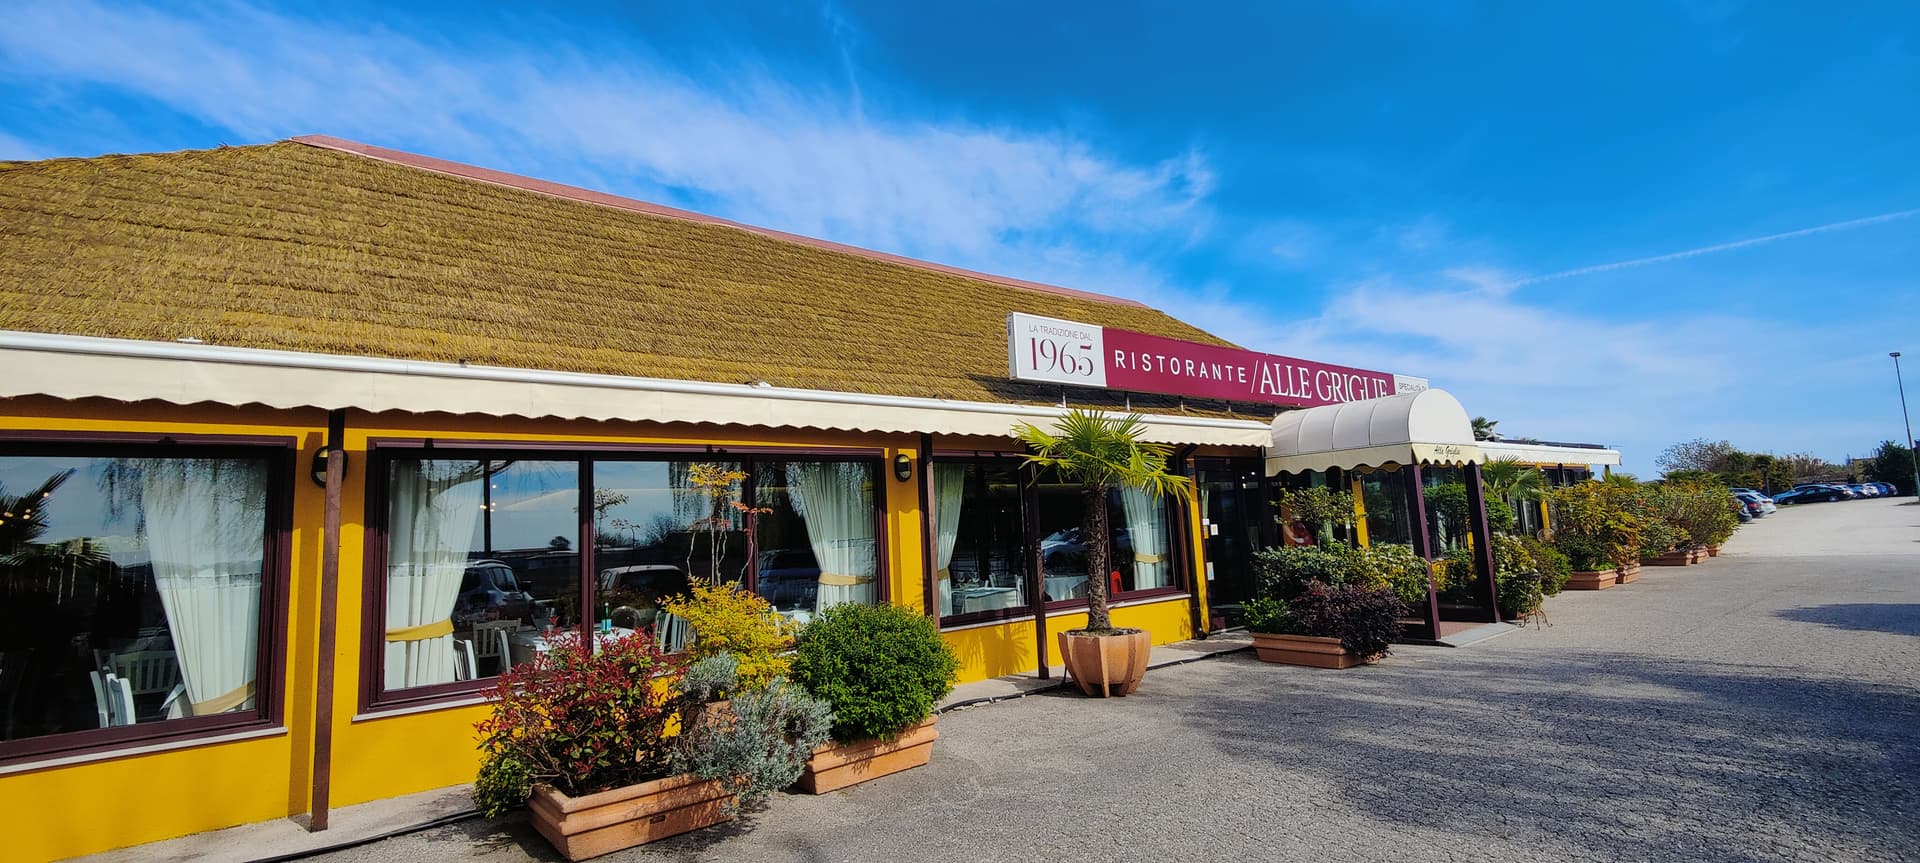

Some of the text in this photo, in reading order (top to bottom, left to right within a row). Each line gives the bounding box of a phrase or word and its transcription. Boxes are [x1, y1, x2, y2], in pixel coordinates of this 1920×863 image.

[1028, 321, 1093, 341] LA TRADIZIONE DAL
[1031, 337, 1094, 377] 1965
[1114, 350, 1247, 384] RISTORANTE
